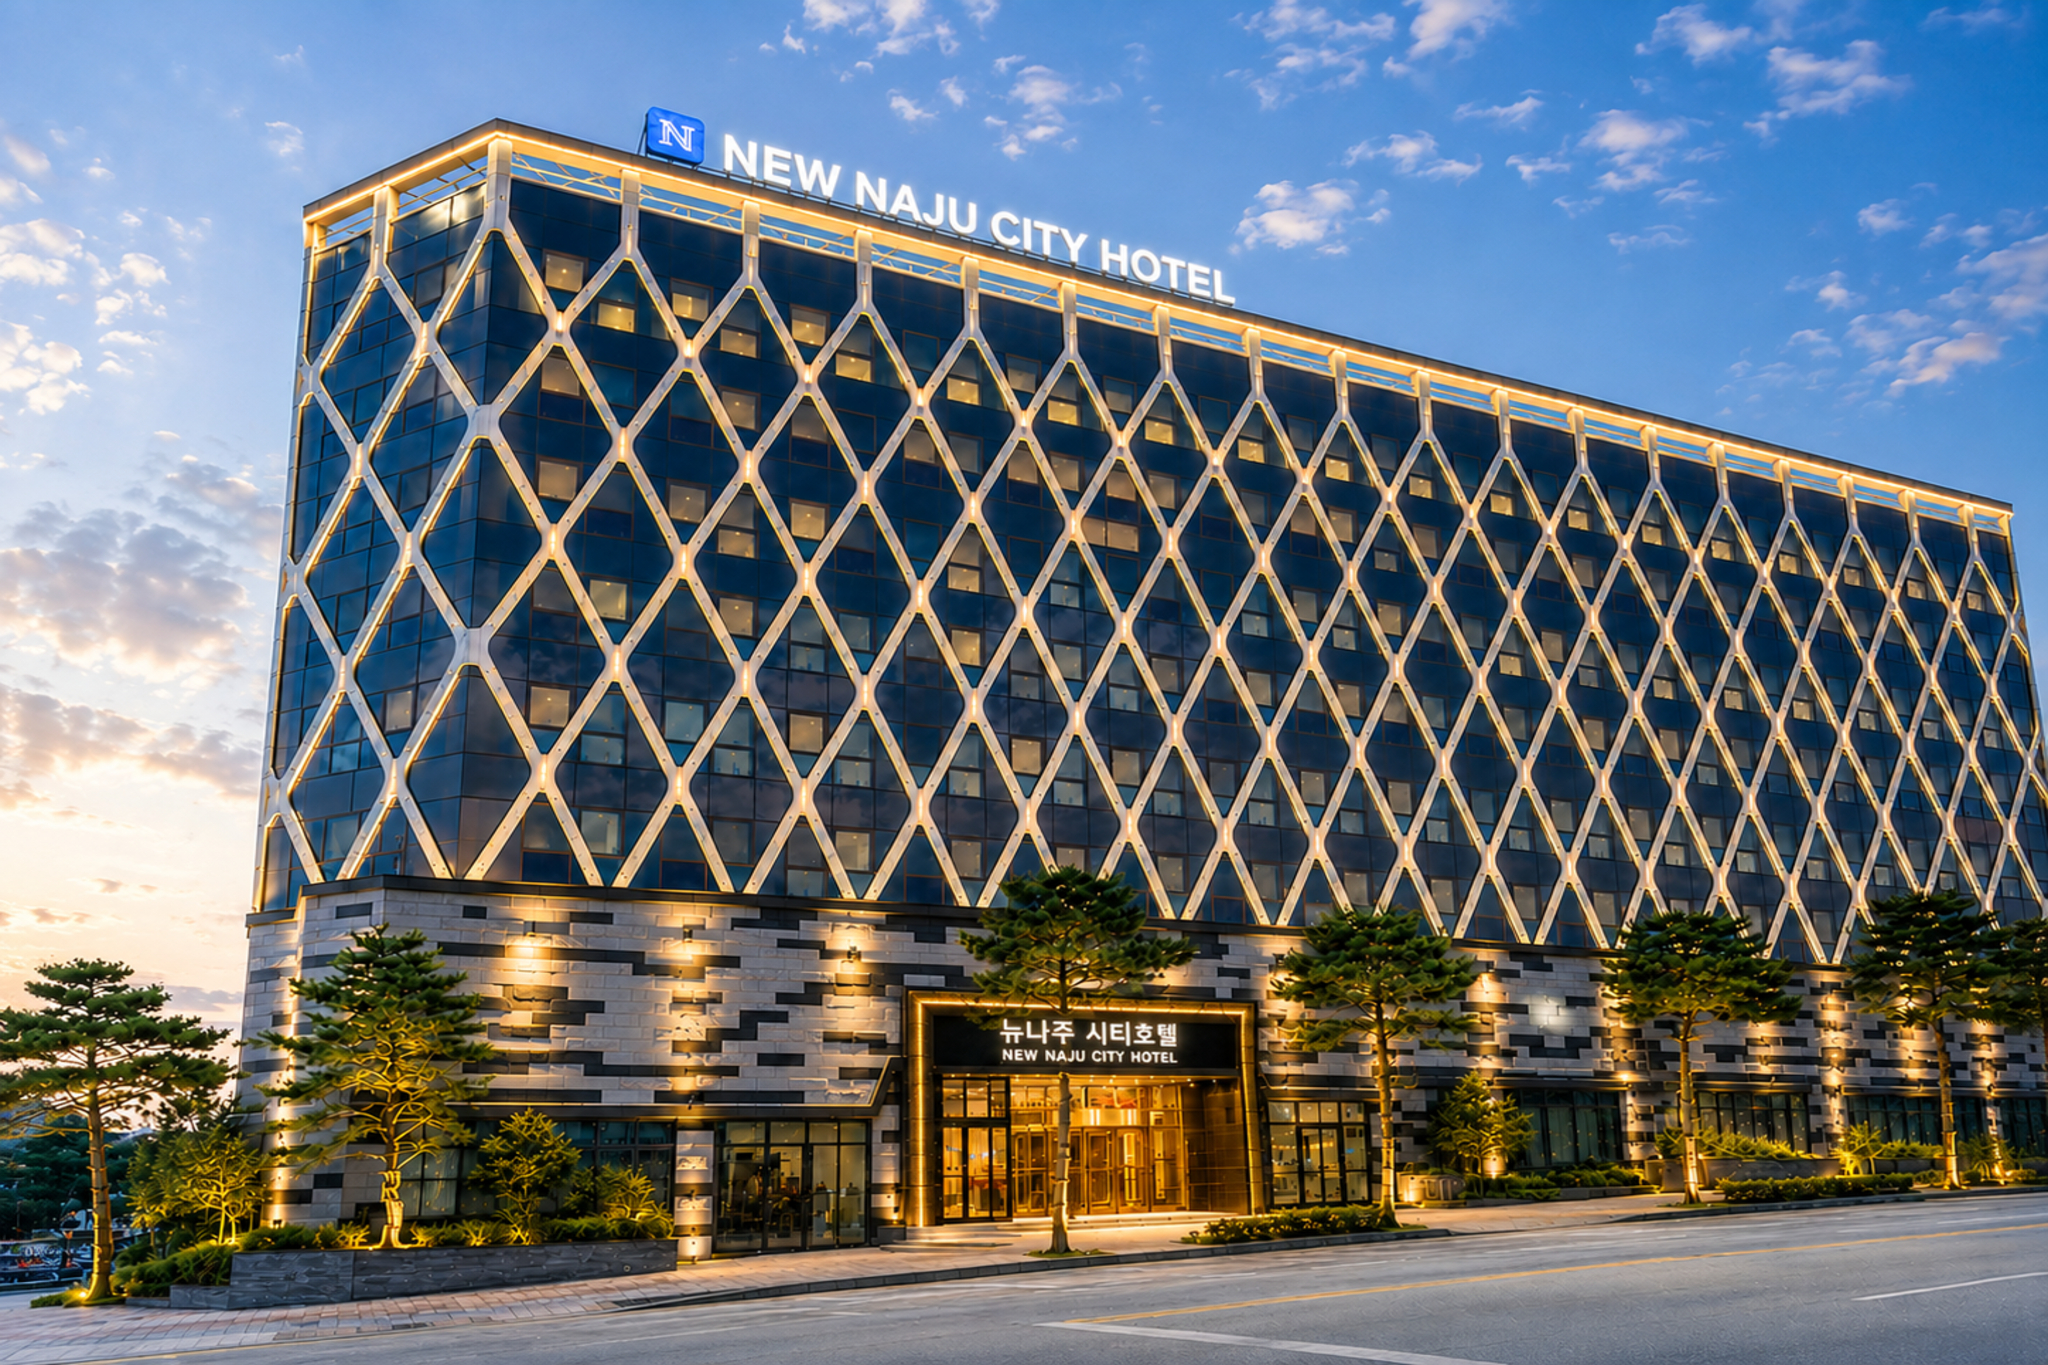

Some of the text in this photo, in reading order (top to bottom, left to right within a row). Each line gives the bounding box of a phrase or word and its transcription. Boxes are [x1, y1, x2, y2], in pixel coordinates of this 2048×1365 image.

[658, 118, 695, 153] N
[723, 133, 1236, 304] NEW NAJU CITY HOTEL
[1000, 1019, 1178, 1047] 뉴나주 시티호텔
[1002, 1048, 1178, 1064] NEW NAJU CITY HOTEL
